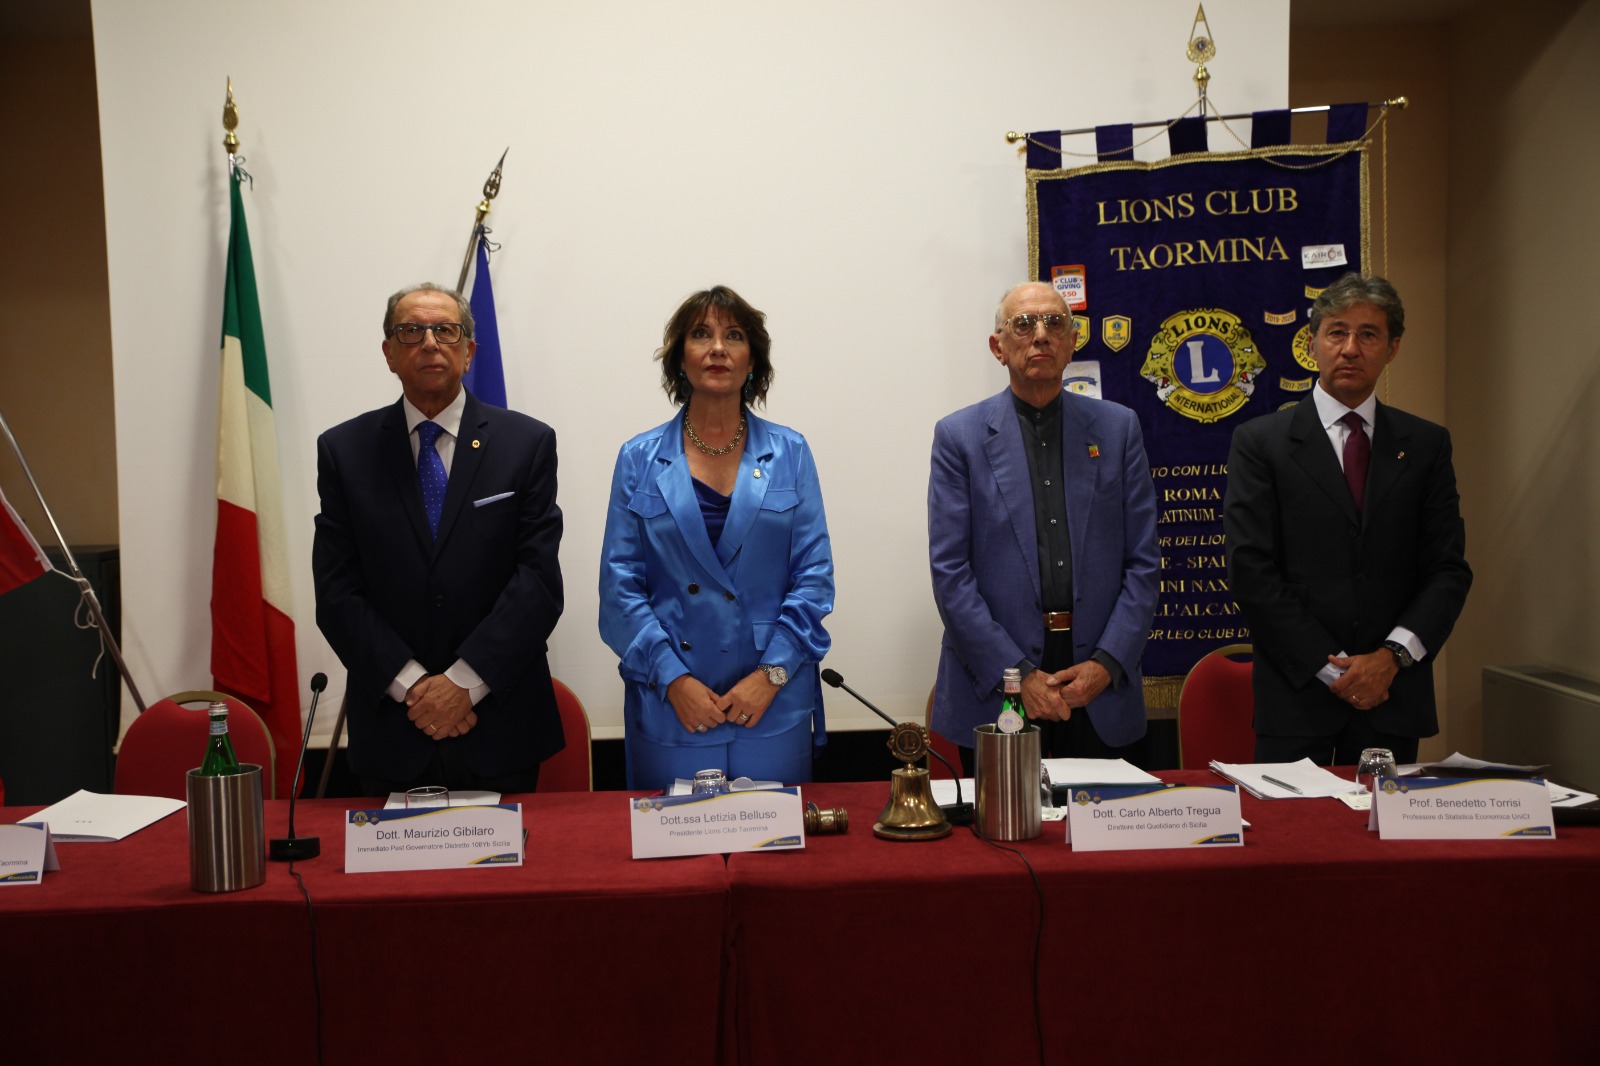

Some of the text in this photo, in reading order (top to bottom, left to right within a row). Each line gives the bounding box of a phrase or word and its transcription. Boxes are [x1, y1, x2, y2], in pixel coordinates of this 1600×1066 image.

[1096, 187, 1298, 225] LIONS CLUB
[1110, 236, 1290, 271] TAORMINA
[1171, 315, 1231, 338] LIONS
[1186, 341, 1220, 383] L
[1296, 352, 1319, 369] SPO
[1174, 393, 1240, 414] INTERNATIONAL
[1171, 465, 1200, 476] CON
[1164, 487, 1221, 502] ROMA
[1157, 508, 1215, 523] ATINUM
[1175, 535, 1197, 546] DEI
[1200, 534, 1226, 546] LIO
[1154, 601, 1241, 617] L'ALCAN
[1167, 629, 1194, 640] LEO
[1198, 628, 1234, 639] CLUB
[1409, 798, 1521, 808] Prof. Benedetto Torrisi
[660, 810, 777, 825] Dott.ssa Letizia Belluso
[1093, 806, 1221, 819] Dott. Carlo Alberto Tregua
[376, 826, 495, 840] Dott. Maurizio Gibilaro
[739, 825, 768, 833] Taormina
[357, 845, 390, 853] Immediato
[405, 843, 443, 851] Governatore
